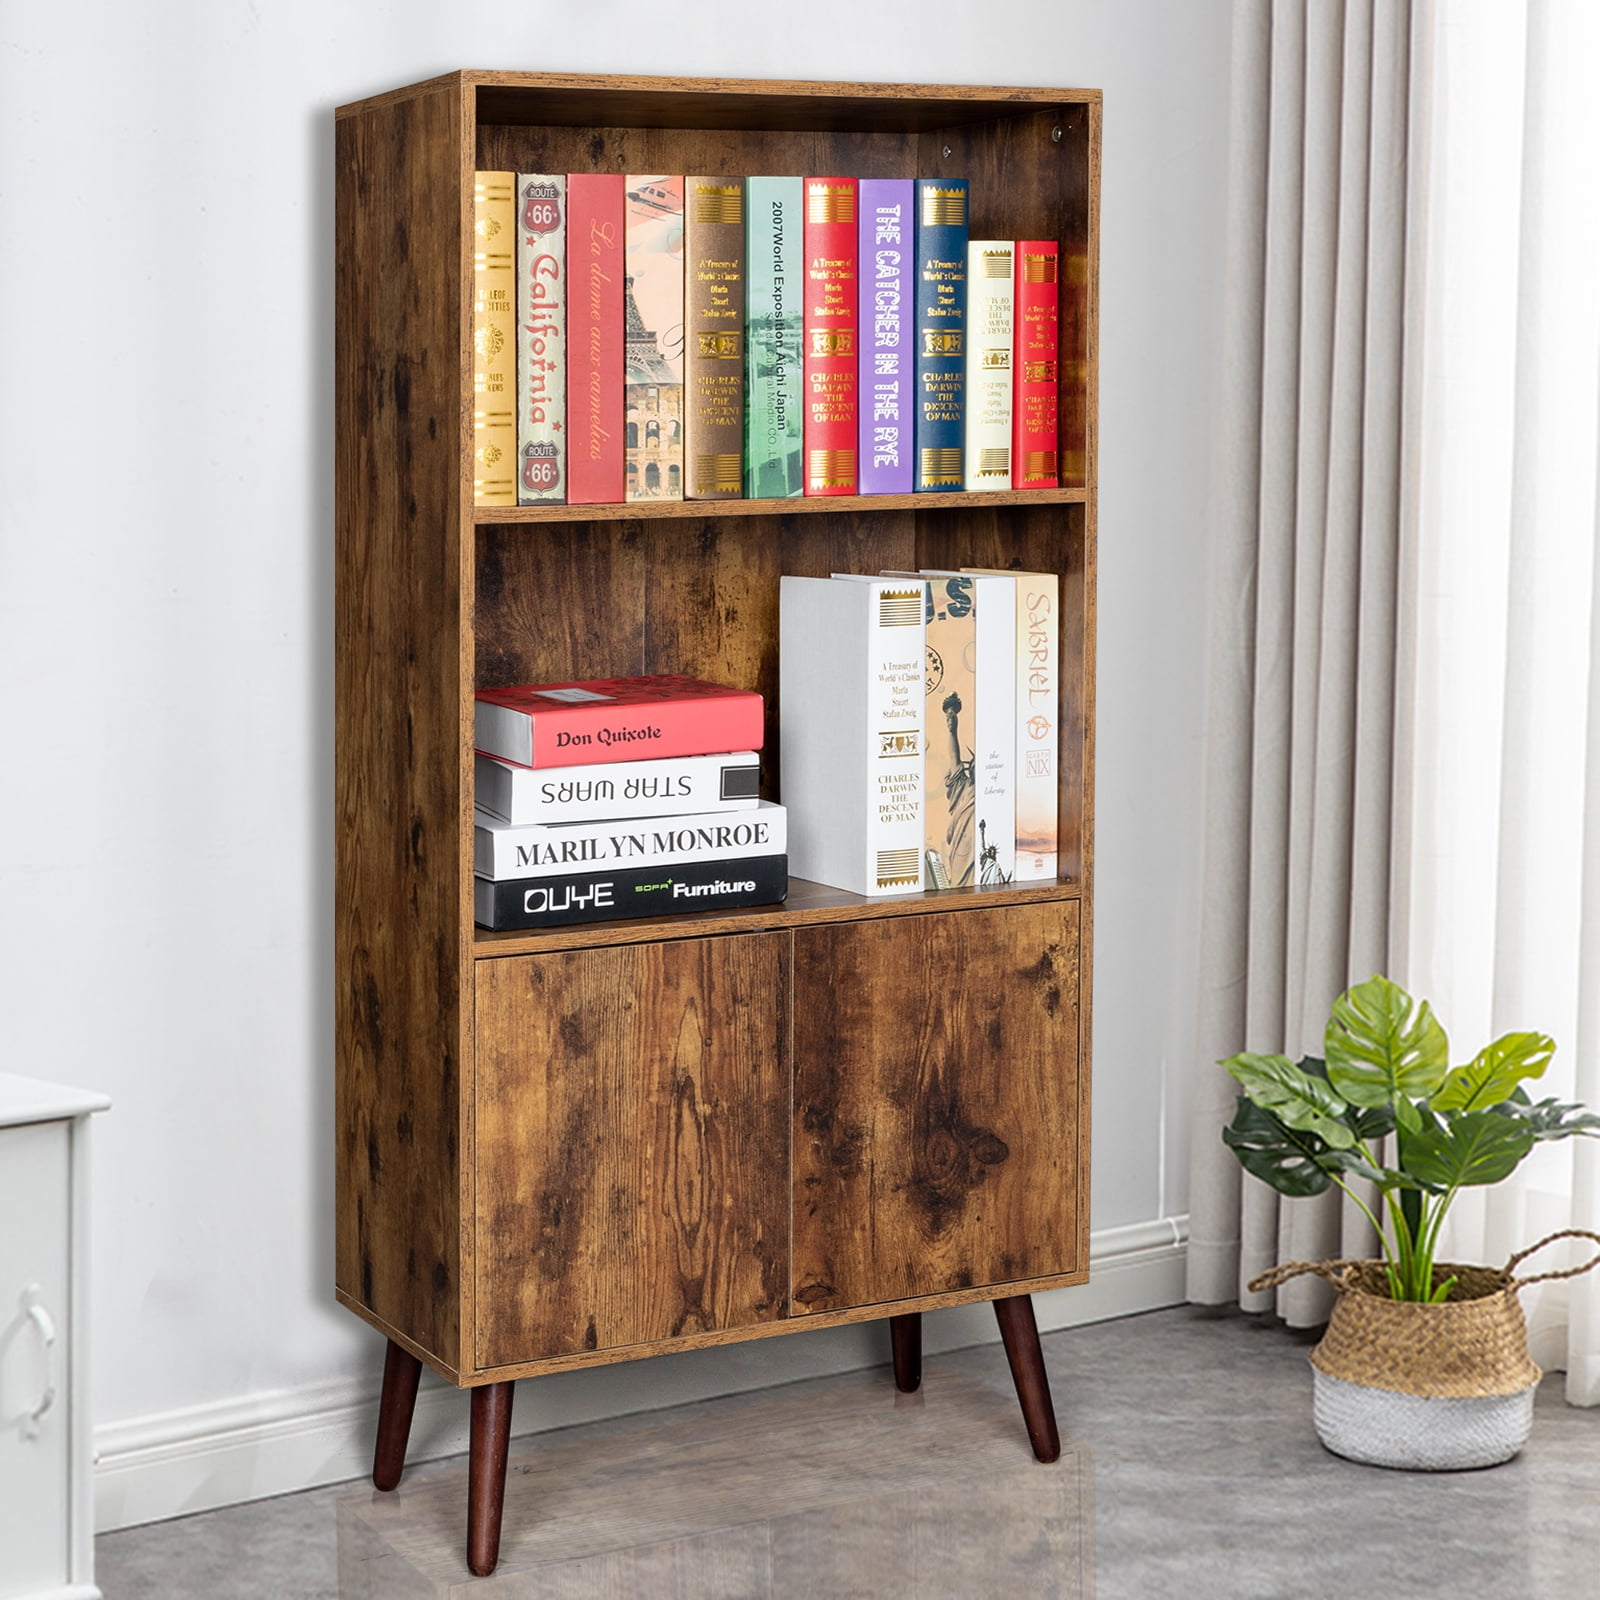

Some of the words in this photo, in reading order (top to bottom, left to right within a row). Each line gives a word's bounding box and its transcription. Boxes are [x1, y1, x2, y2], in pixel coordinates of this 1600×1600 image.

[530, 188, 555, 198] ROUTE
[532, 205, 552, 224] 66
[876, 204, 901, 245] THE
[590, 218, 616, 256] La
[590, 262, 611, 320] dame
[874, 250, 901, 347] CATCHER
[772, 276, 786, 348] Exposition
[523, 254, 559, 424] California
[590, 326, 600, 366] aux
[774, 352, 786, 386] Aichi
[874, 353, 899, 375] IN
[697, 376, 740, 385] CHARLES
[810, 373, 855, 382] CHARLES
[925, 383, 962, 391] DARWIN
[710, 397, 729, 405] THE
[775, 390, 787, 430] Japan
[873, 381, 899, 421] THE
[590, 371, 611, 460] camelias
[715, 417, 737, 425] MAN
[814, 413, 829, 422] OF
[926, 412, 941, 421] OF
[941, 412, 960, 420] MAN
[528, 446, 554, 456] ROUTE
[873, 427, 899, 468] RYE
[531, 463, 551, 482] 66
[888, 661, 912, 672] Treasury
[892, 698, 909, 706] Stuart
[556, 731, 593, 748] Don
[597, 725, 662, 747] Quixote
[1028, 758, 1049, 775] NIX
[624, 775, 692, 799] STAR
[878, 773, 920, 784] CHARLES
[881, 783, 917, 793] DARWIN
[541, 780, 615, 804] WARS
[892, 794, 908, 803] THE
[879, 802, 920, 813] DESCENT
[881, 813, 893, 823] OF
[896, 812, 916, 821] MAN
[516, 834, 646, 868] MARILYN
[652, 822, 769, 854] MONROE
[673, 879, 757, 898] Furniture
